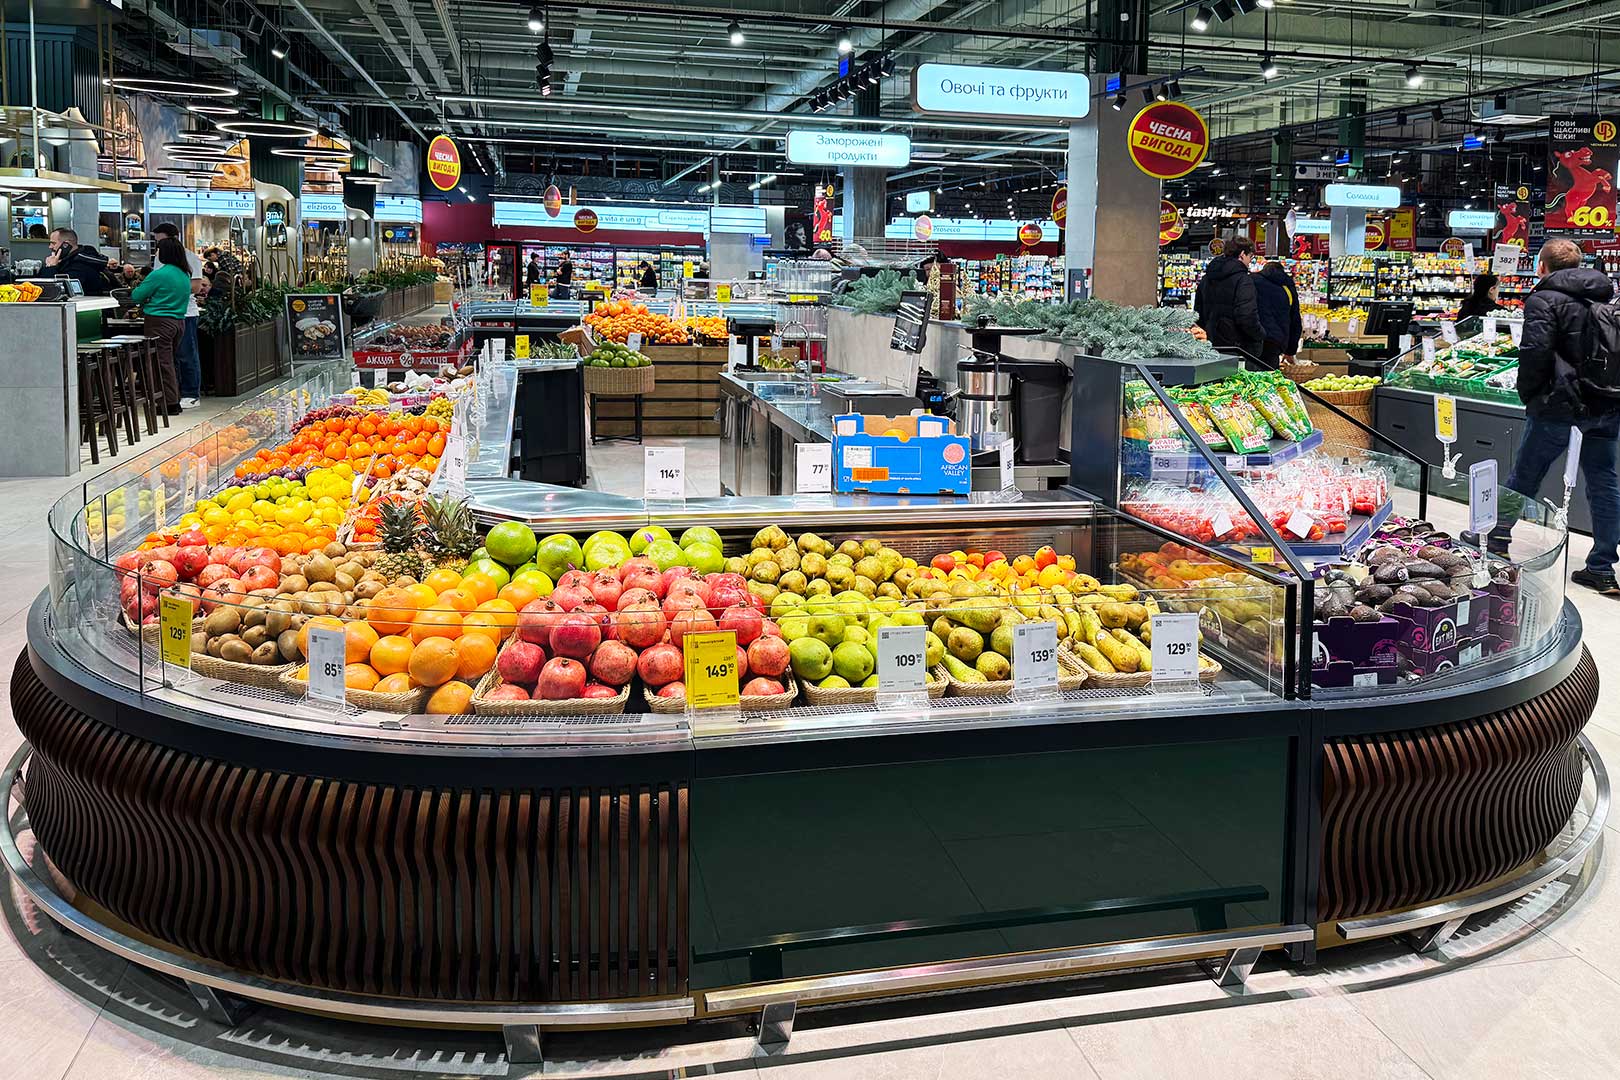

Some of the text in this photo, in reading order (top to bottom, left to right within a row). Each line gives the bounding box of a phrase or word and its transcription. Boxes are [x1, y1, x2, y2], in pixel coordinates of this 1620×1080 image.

[940, 78, 1068, 102] Овочі та фрукти
[1149, 121, 1192, 141] ЧЕСНА
[816, 134, 883, 150] Заморожені
[1140, 135, 1191, 158] ВИГОДА
[434, 151, 454, 162] ЧЕСНА
[828, 151, 878, 162] продукти
[433, 162, 455, 174] ВИГОДА
[660, 469, 675, 479] 114
[812, 464, 824, 474] 77
[169, 626, 182, 640] 129
[1030, 649, 1049, 663] 139
[1166, 643, 1186, 655] 129
[895, 654, 916, 667] 109
[324, 662, 337, 677] 85
[705, 664, 728, 678] 149
